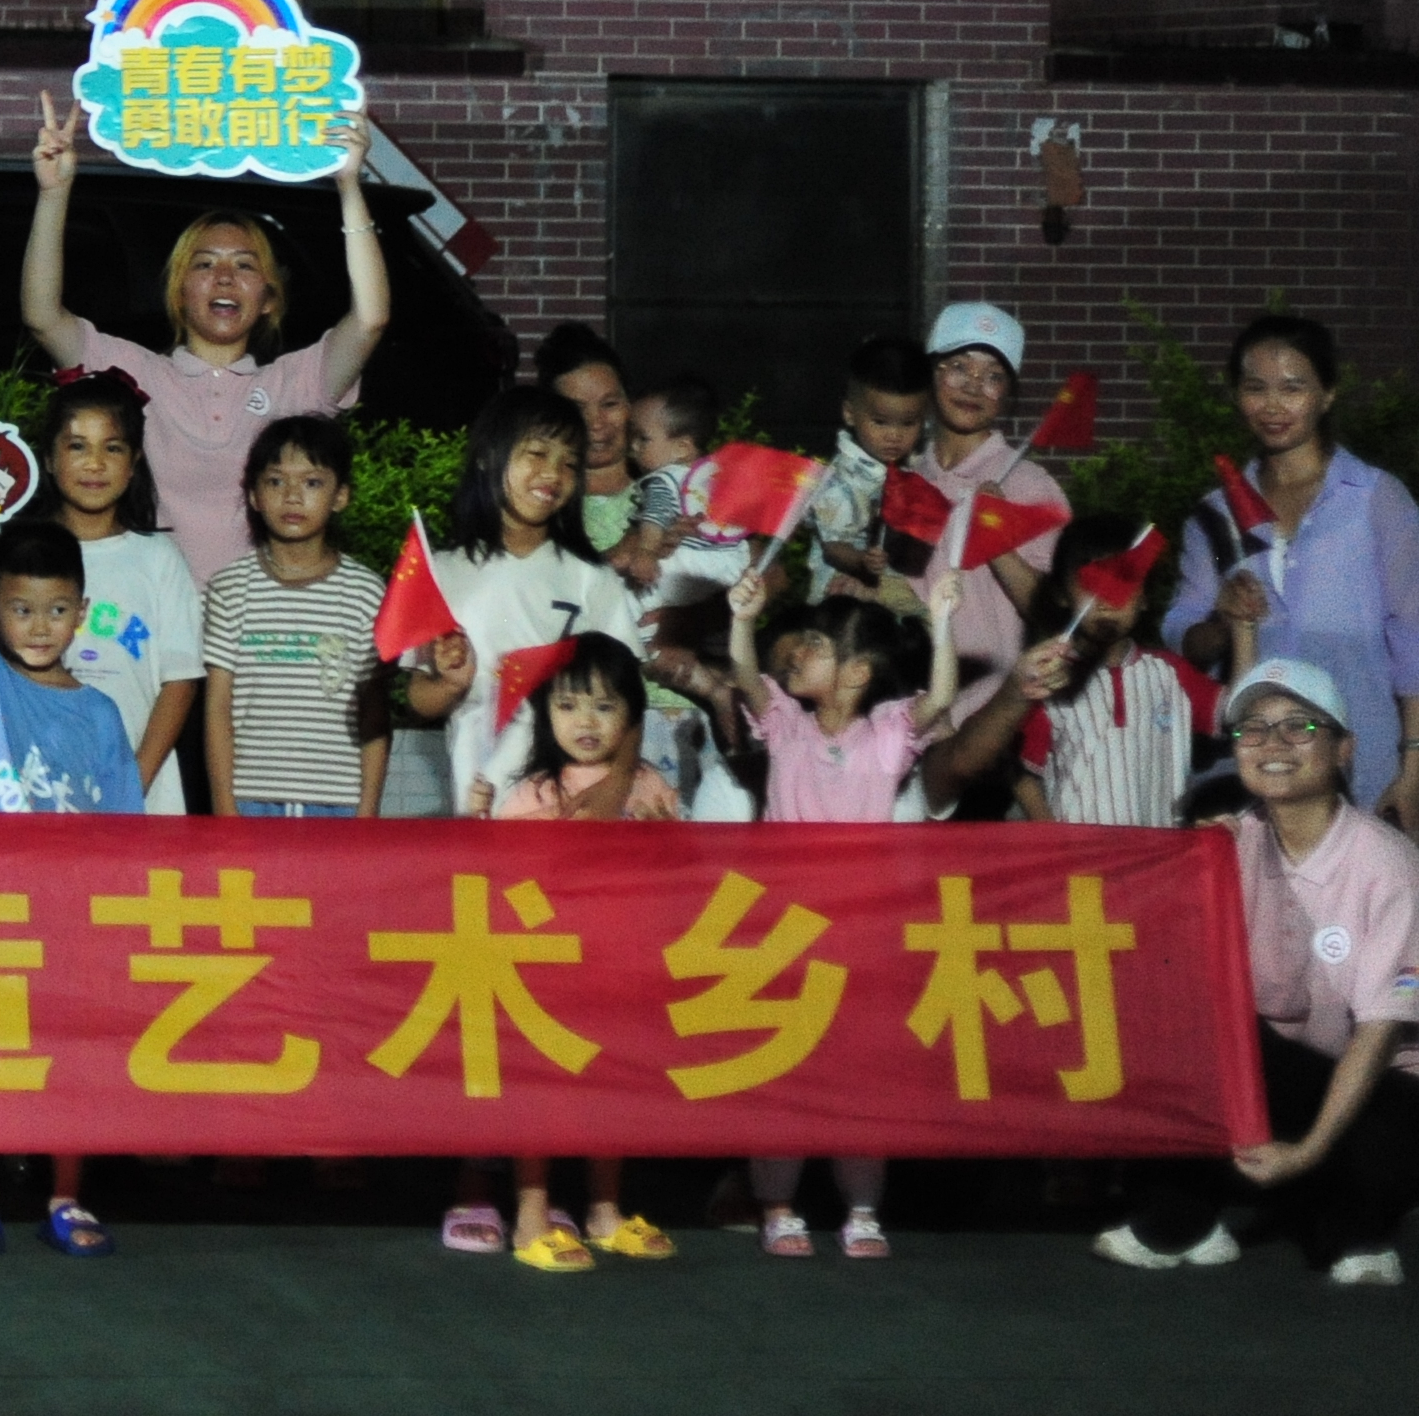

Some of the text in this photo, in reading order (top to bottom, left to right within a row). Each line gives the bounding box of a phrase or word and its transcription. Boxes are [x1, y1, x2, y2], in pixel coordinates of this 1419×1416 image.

[119, 42, 333, 95] 青春有梦
[121, 96, 334, 149] 勇敢前行
[550, 599, 582, 640] 7
